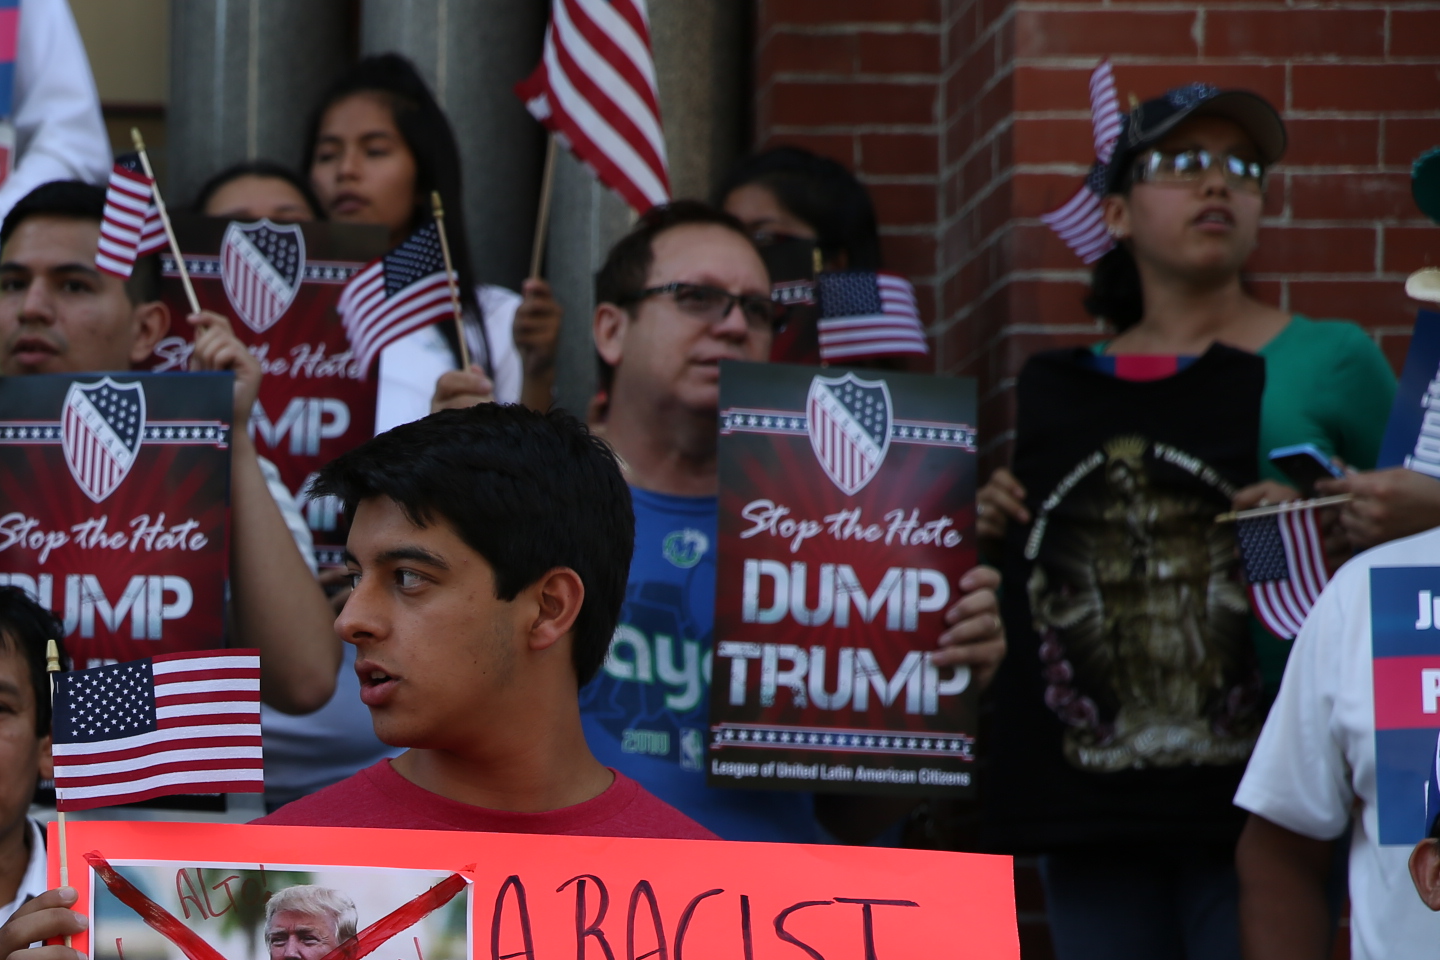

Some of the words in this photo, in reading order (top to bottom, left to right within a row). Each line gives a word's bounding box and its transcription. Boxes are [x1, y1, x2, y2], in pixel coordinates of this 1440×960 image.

[75, 398, 125, 459] LULAC
[71, 514, 129, 551] the
[129, 512, 209, 553] Hate
[739, 498, 824, 553] Stop
[823, 506, 884, 543] the
[884, 507, 963, 548] Hate
[741, 557, 951, 632] DUMP
[717, 641, 972, 716] TRUMP
[711, 759, 760, 779] League
[760, 761, 776, 777] of
[776, 761, 819, 779] United
[820, 764, 853, 782] Latin
[854, 765, 916, 784] American
[918, 767, 971, 786] Citizens
